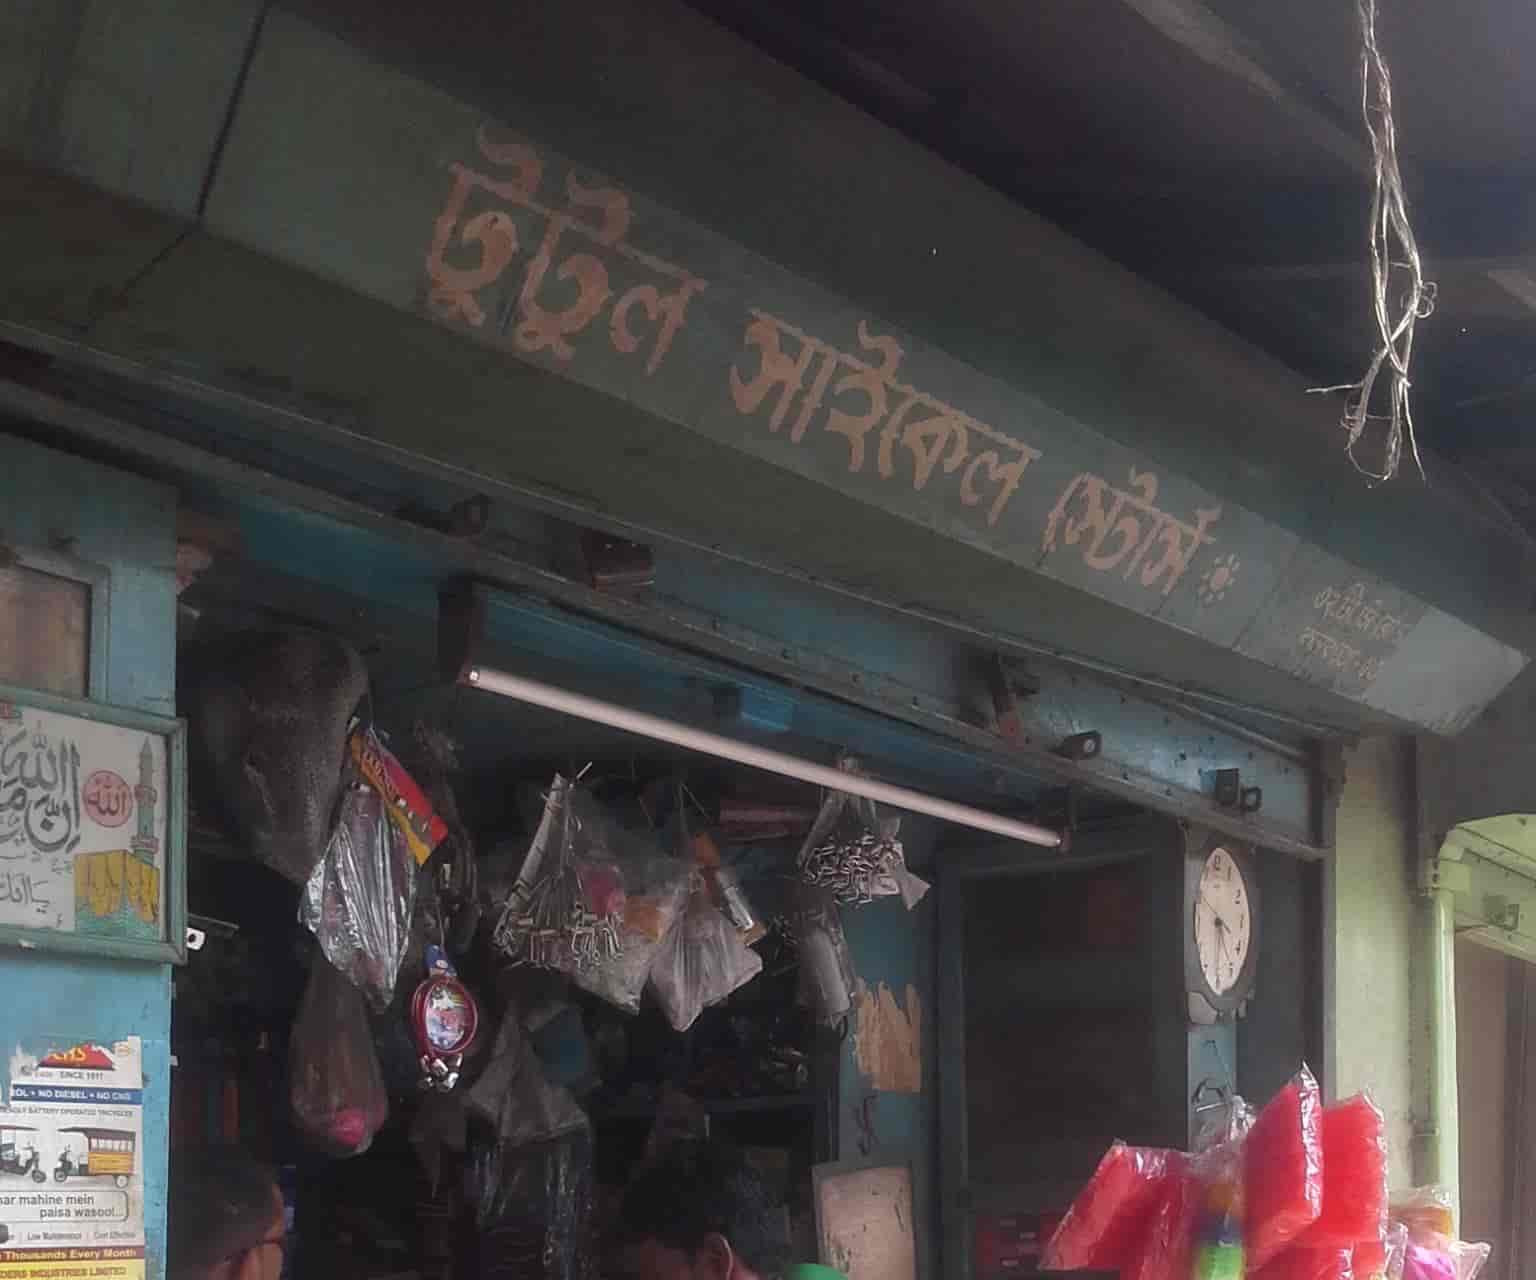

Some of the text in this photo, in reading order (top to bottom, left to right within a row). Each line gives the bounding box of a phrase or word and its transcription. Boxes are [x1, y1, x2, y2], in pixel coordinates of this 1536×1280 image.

[729, 308, 1044, 528] সাইকেল
[19, 1192, 64, 1206] mahine
[66, 1193, 95, 1206] mein
[40, 1206, 71, 1219] paisa
[6, 1248, 136, 1261] Thousands Every Month
